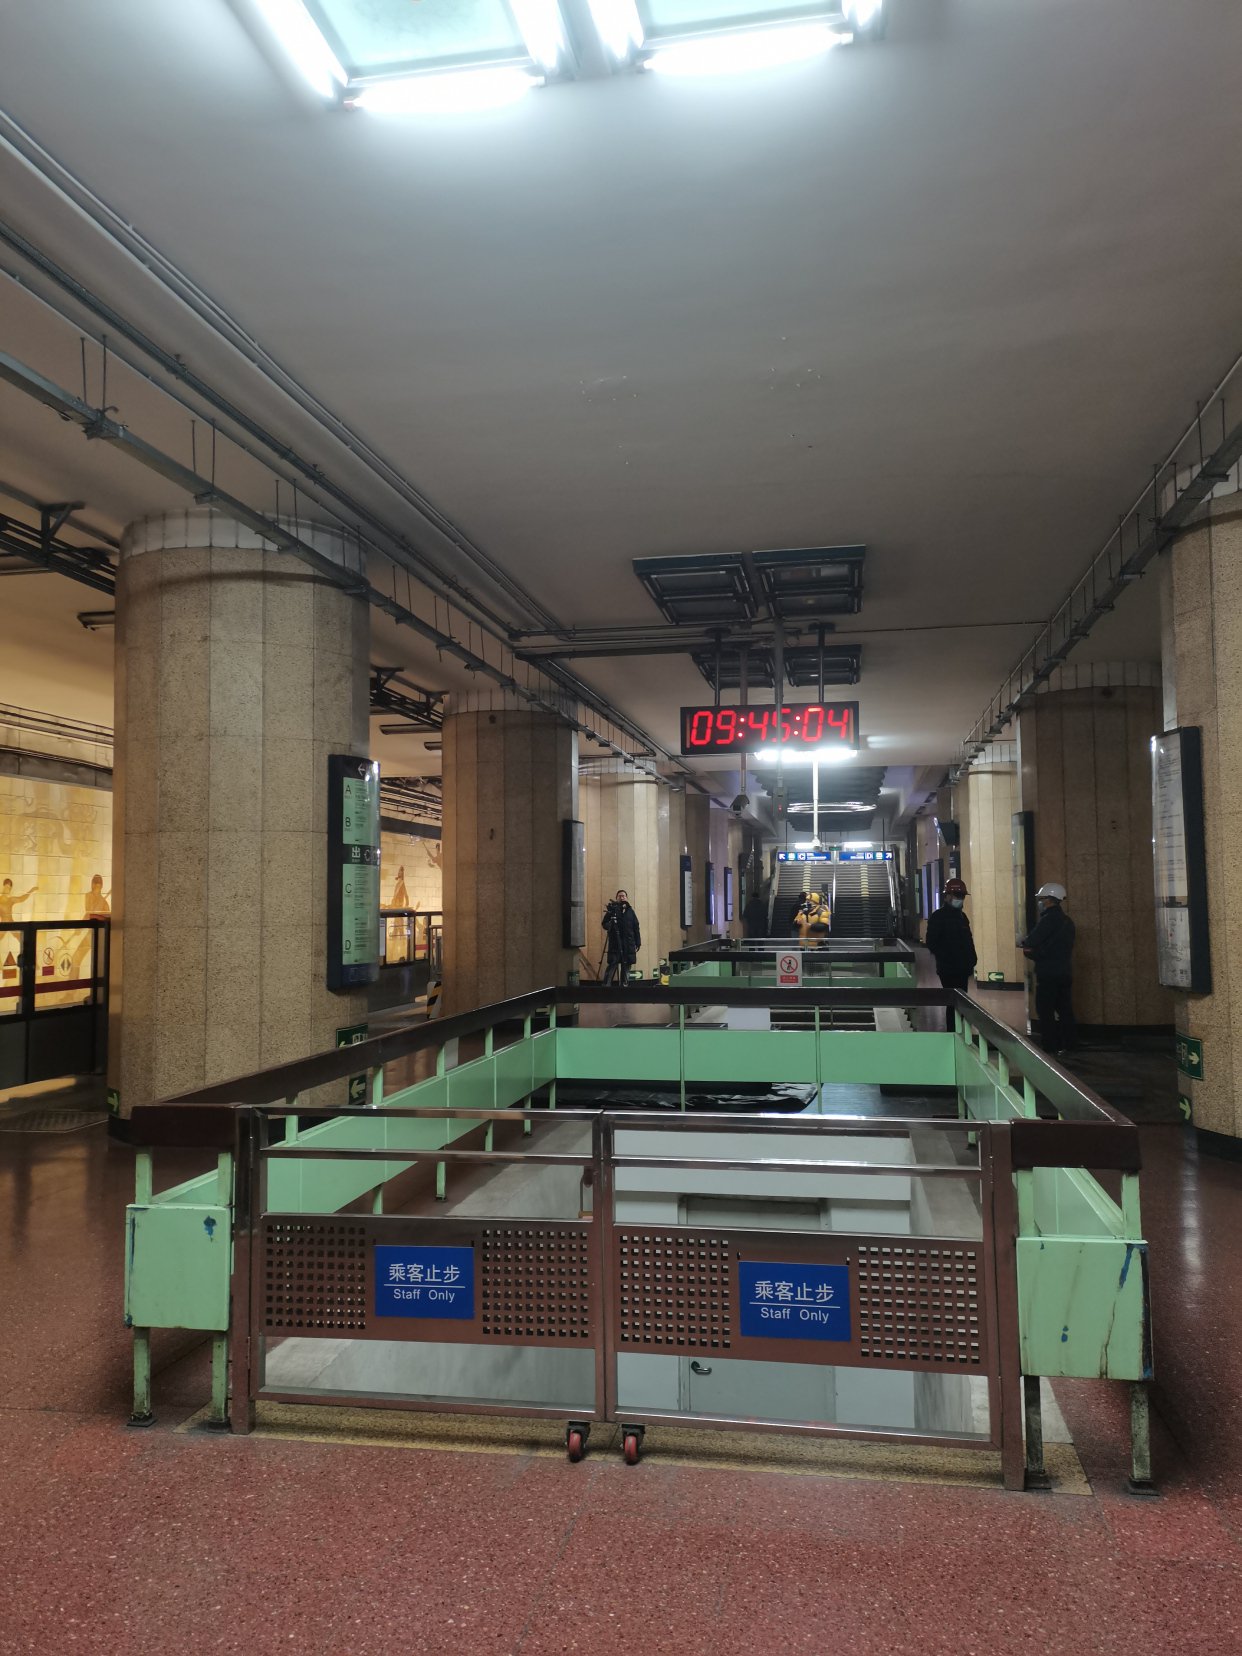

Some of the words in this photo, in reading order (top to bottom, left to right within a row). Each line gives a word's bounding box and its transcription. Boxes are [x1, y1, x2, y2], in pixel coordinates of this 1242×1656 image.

[690, 705, 849, 745] 09:45:04
[345, 784, 352, 794] A
[345, 816, 352, 827] B
[345, 883, 352, 893] C
[345, 939, 352, 950] D
[388, 1263, 461, 1283] 乘客止步
[393, 1288, 421, 1300] Staff
[428, 1289, 456, 1303] Only
[754, 1280, 835, 1303] 乘客止步
[760, 1307, 791, 1320] Staff
[799, 1309, 830, 1324] Only
